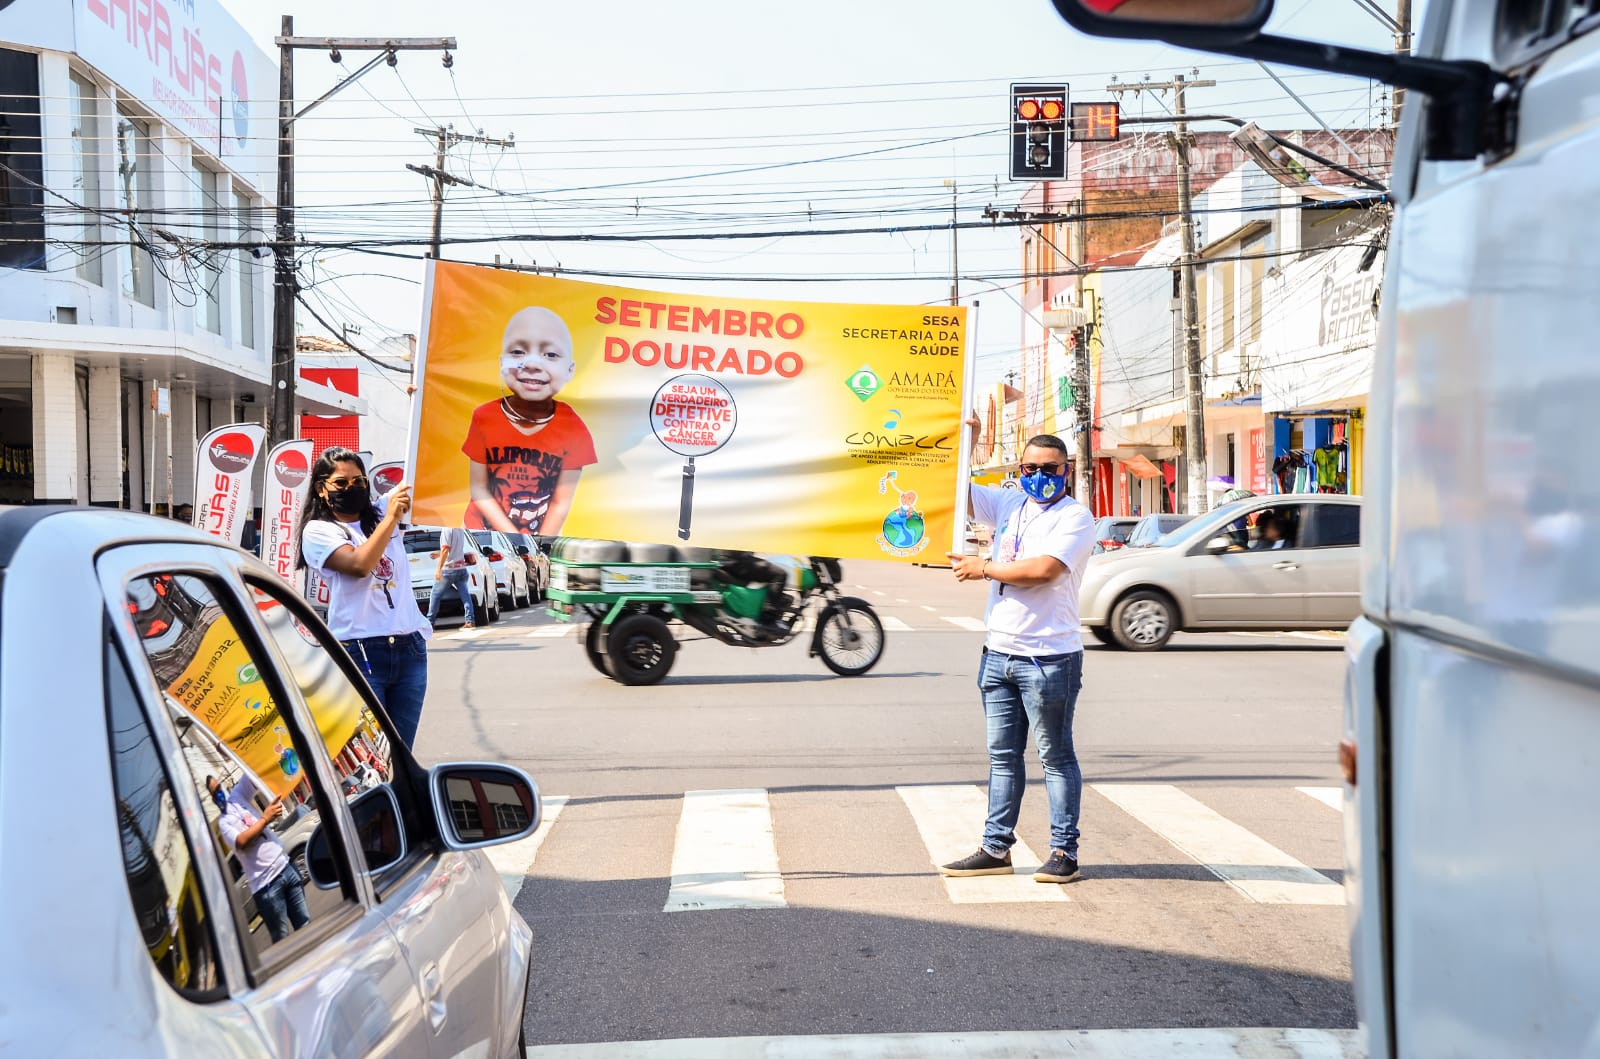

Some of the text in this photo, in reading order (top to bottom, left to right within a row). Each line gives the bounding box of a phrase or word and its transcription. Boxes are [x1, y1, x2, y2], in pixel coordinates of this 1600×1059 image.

[1087, 105, 1116, 138] 14
[594, 296, 805, 340] SETEMBRO
[922, 315, 960, 327] SESA
[842, 328, 959, 342] SECRETARIA DA
[909, 343, 959, 357] SAÚDE
[604, 336, 804, 379] DOURADO
[888, 370, 957, 388] AMAPÁ
[671, 385, 717, 397] SEJA UM
[661, 394, 728, 408] VERDADEIRO
[655, 403, 732, 422] DETETIVE
[663, 418, 721, 431] CONTRA O
[668, 427, 714, 441] CÂNCER
